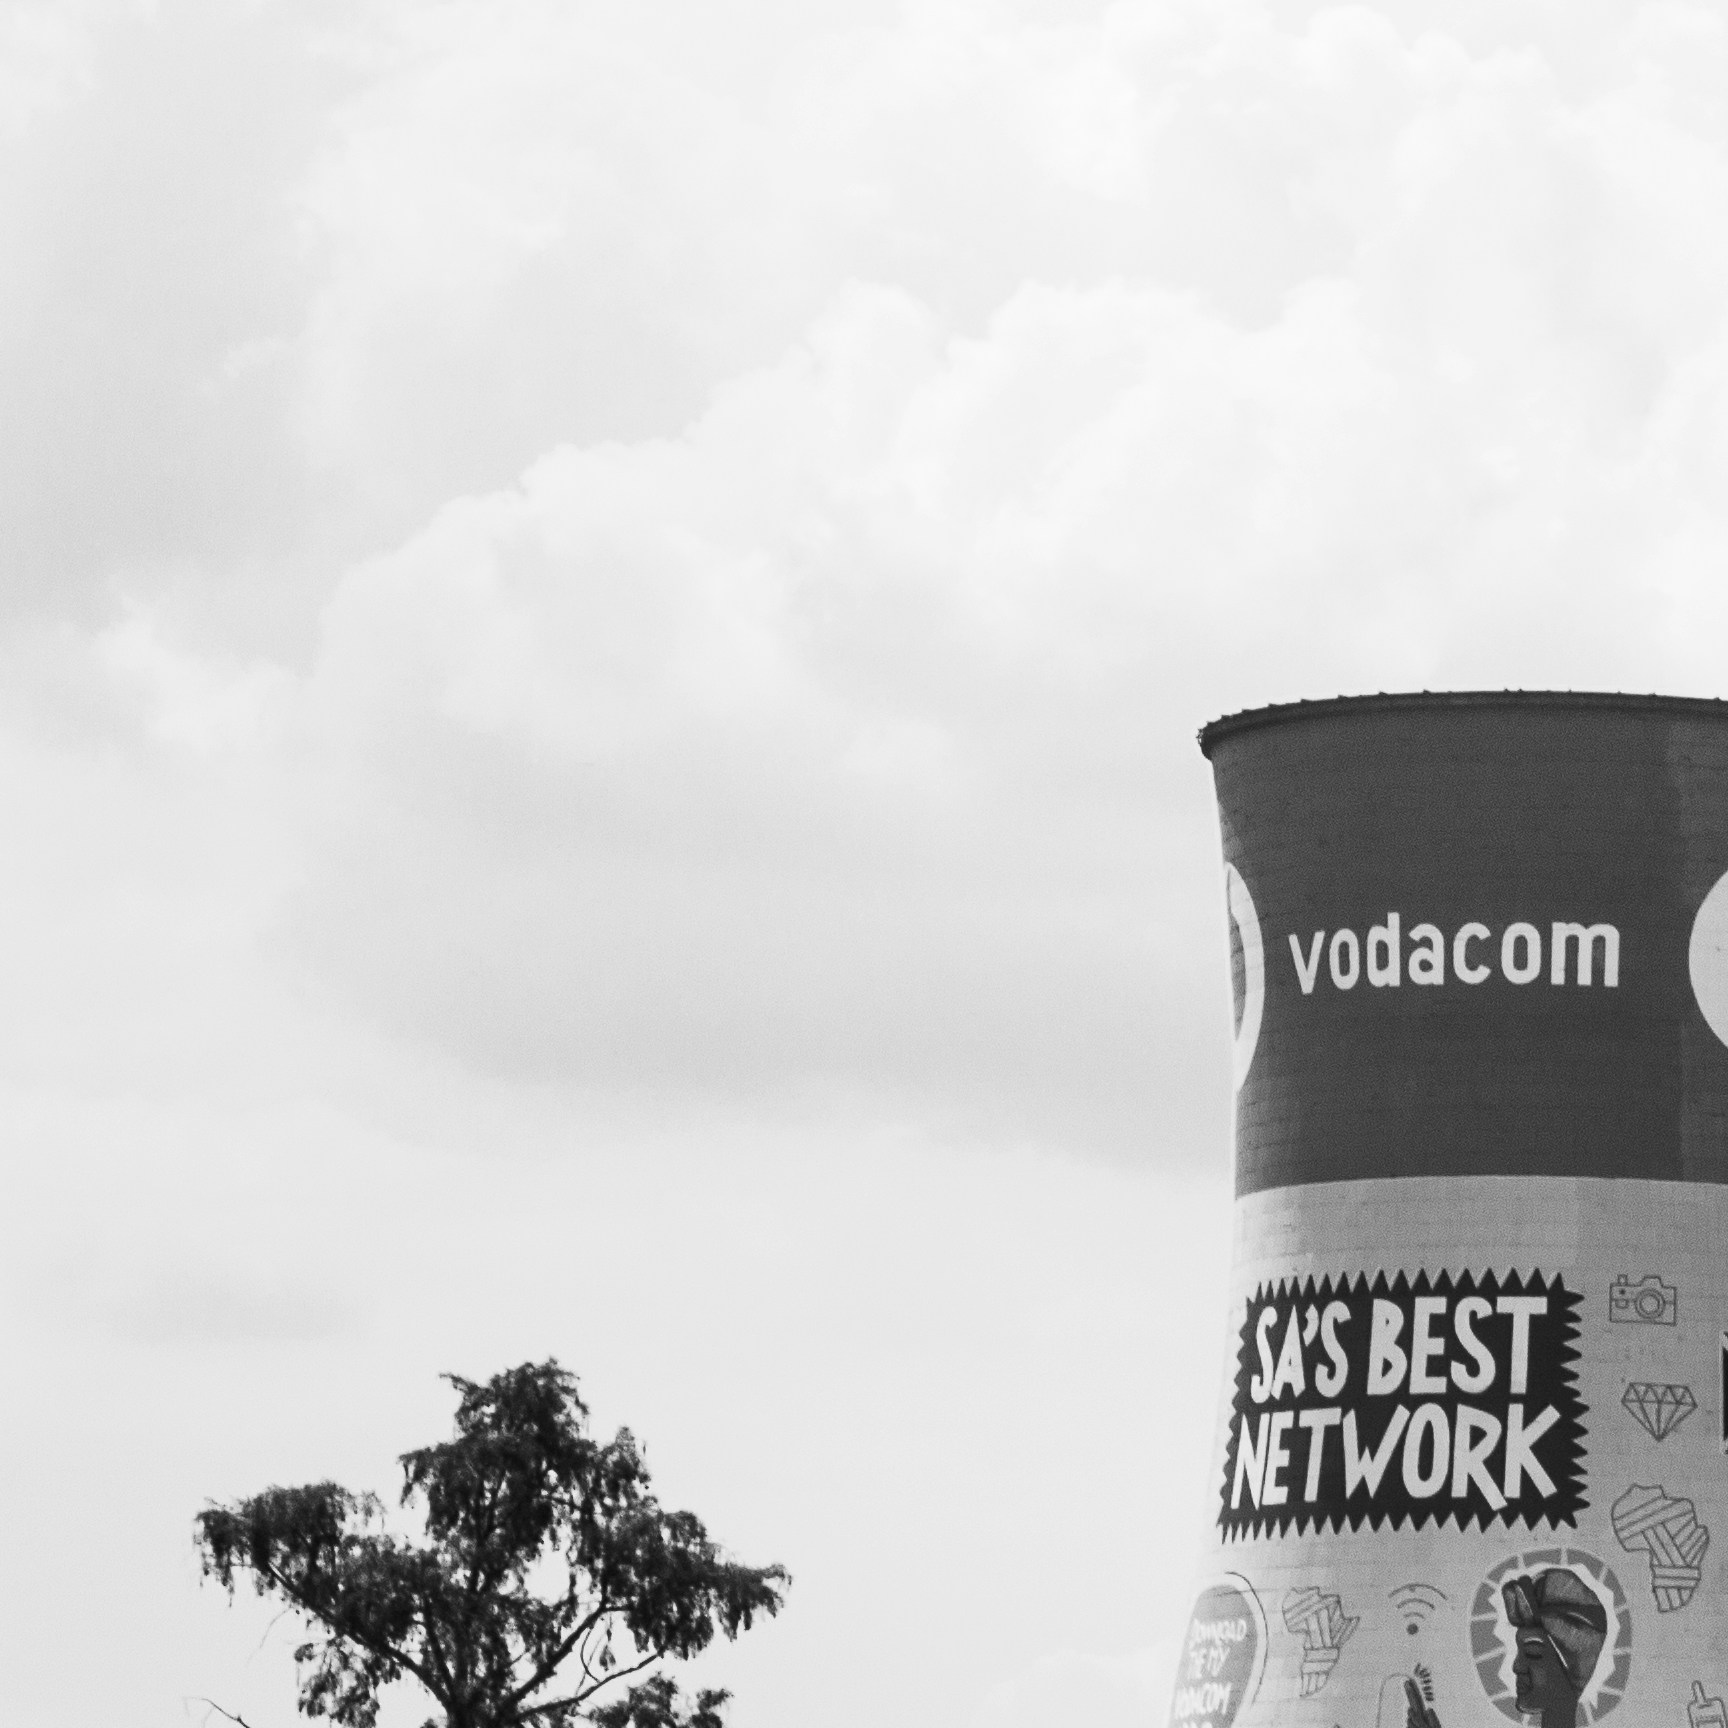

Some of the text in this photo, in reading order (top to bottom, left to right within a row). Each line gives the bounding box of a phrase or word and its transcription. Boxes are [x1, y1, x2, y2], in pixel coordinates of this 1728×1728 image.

[1288, 911, 1620, 995] vodacom
[1250, 1295, 1548, 1403] SA'S BEST
[1230, 1402, 1561, 1511] NETWORK
